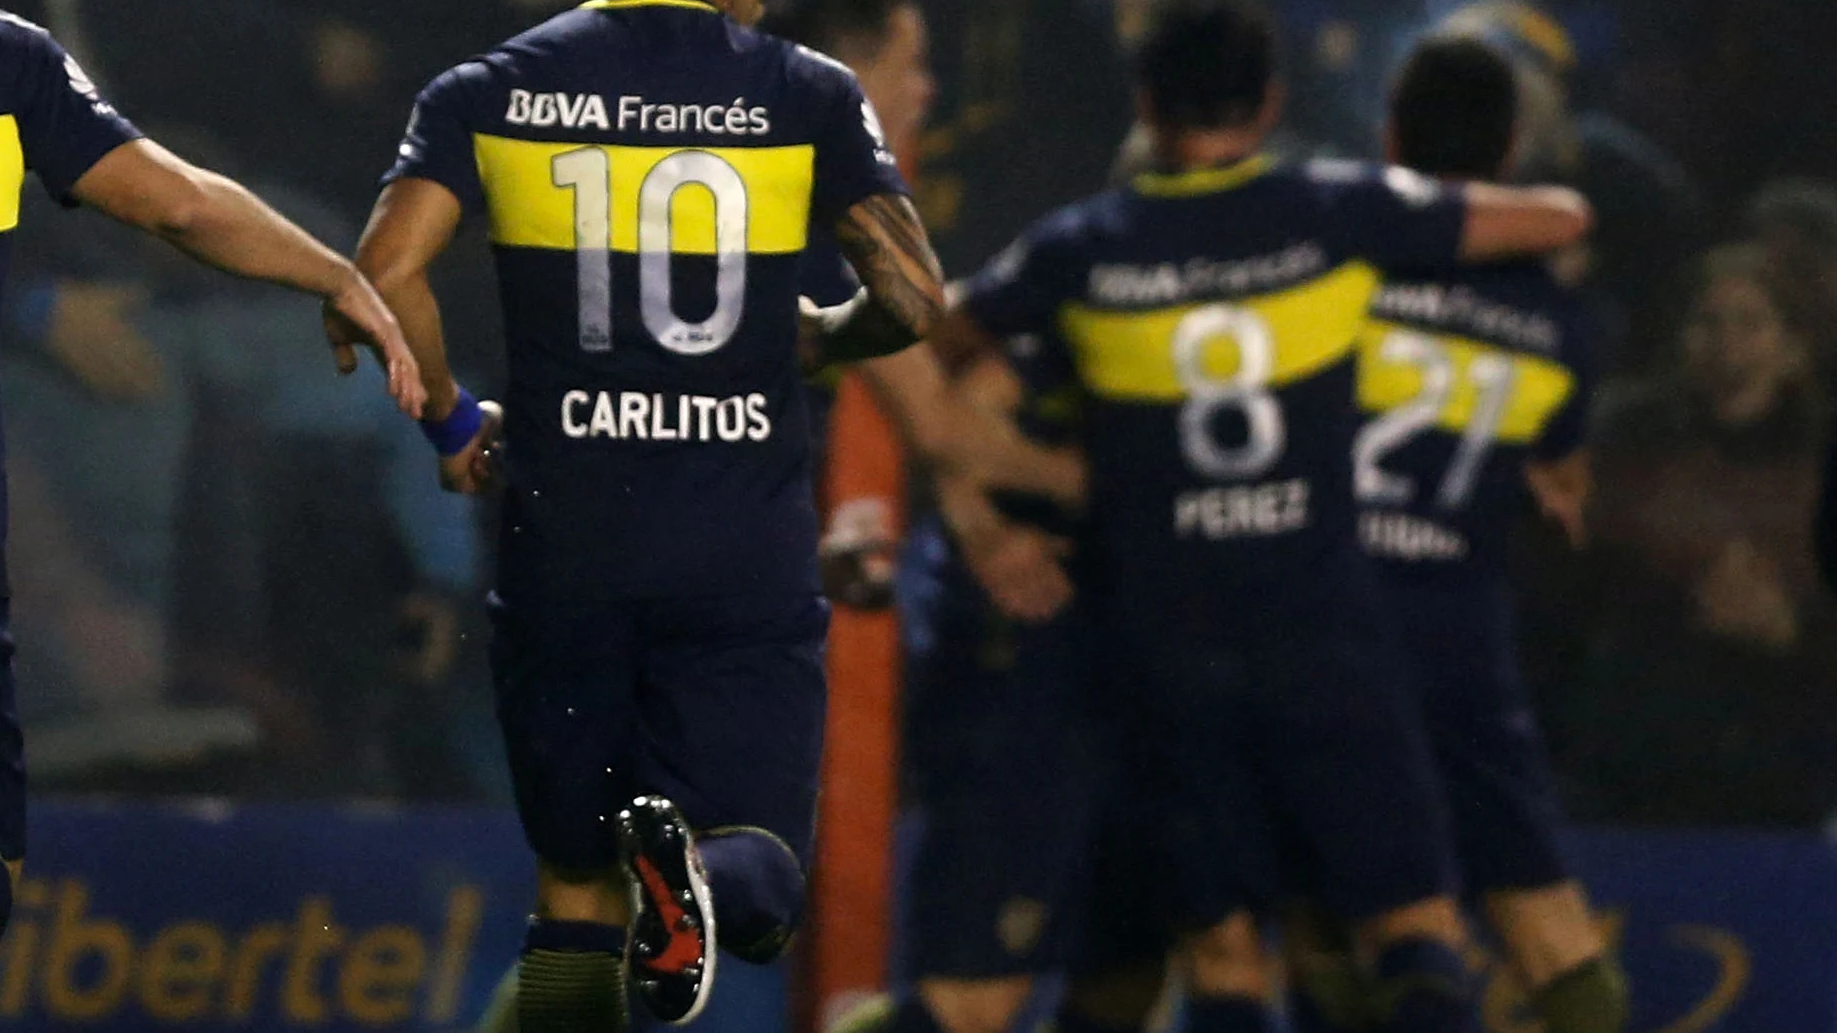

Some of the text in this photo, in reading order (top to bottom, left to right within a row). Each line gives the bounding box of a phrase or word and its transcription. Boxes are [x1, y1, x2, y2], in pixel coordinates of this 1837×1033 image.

[505, 88, 771, 136] BBVA Francés
[550, 146, 748, 356] 10
[561, 389, 771, 442] CARLITOS
[1170, 301, 1288, 479] 8
[1351, 328, 1518, 508] 21
